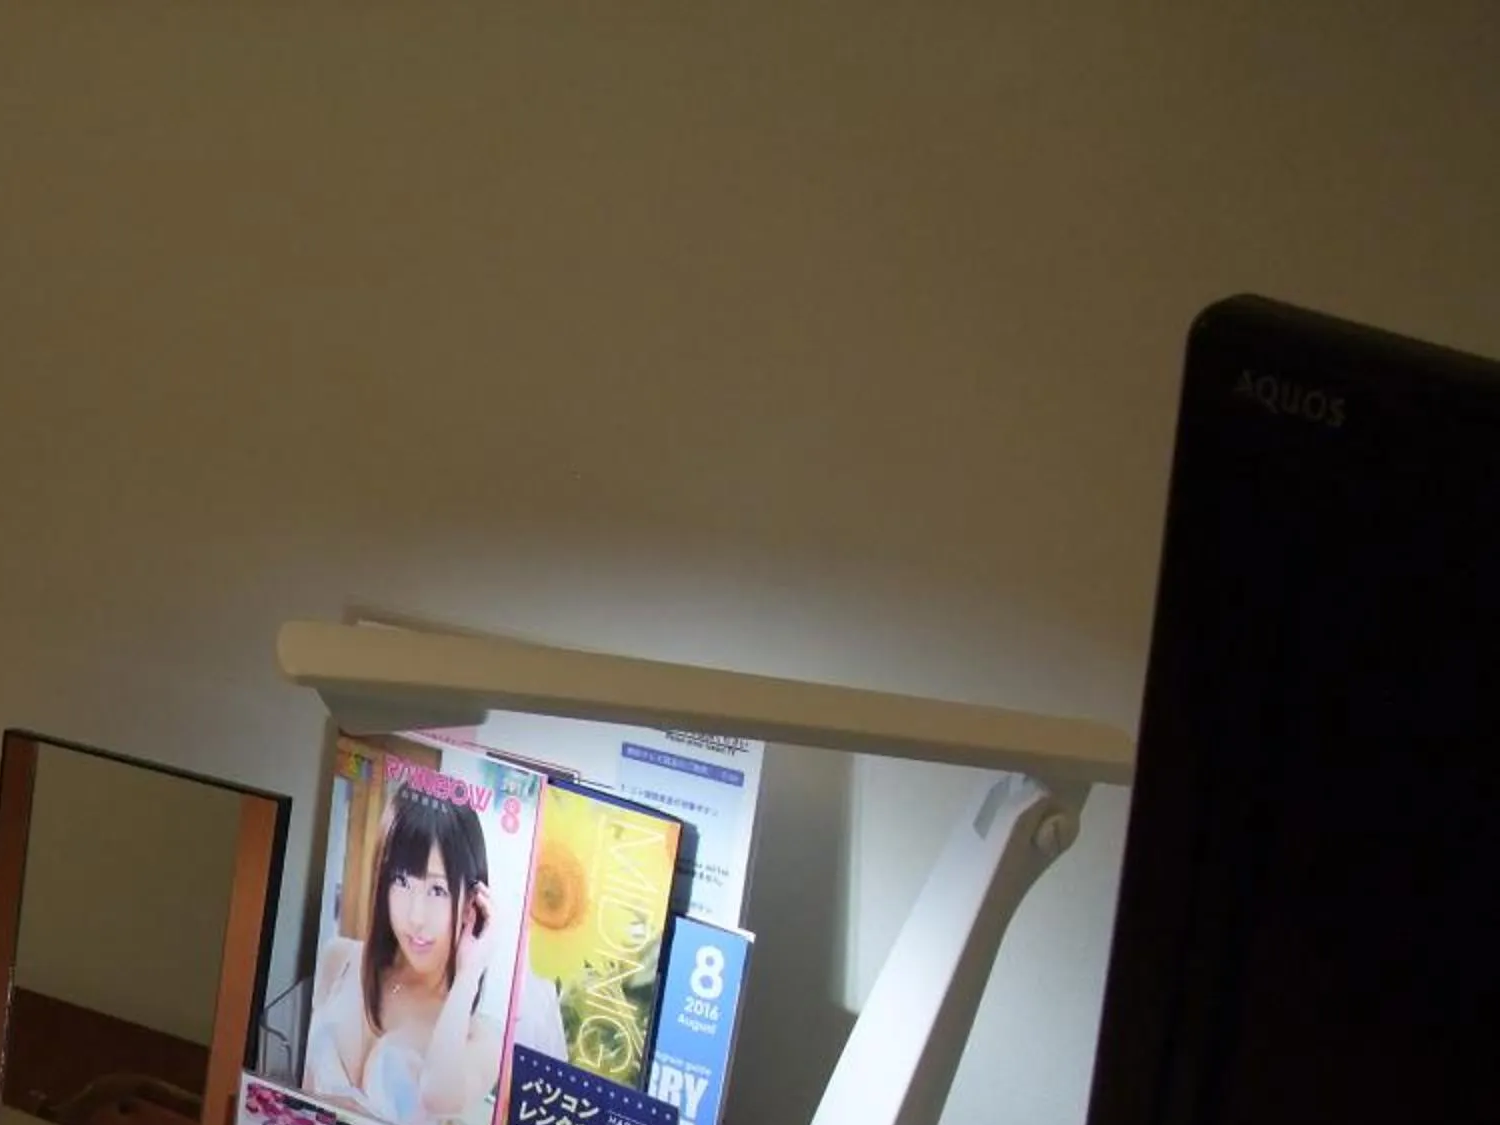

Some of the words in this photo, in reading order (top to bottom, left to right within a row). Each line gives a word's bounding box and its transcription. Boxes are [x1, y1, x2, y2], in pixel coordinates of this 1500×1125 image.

[1232, 368, 1347, 428] AQUOS
[501, 796, 521, 835] 8
[690, 945, 724, 999] 8
[676, 1012, 717, 1035] August
[683, 997, 719, 1021] 2016
[522, 1077, 599, 1118] パソコン
